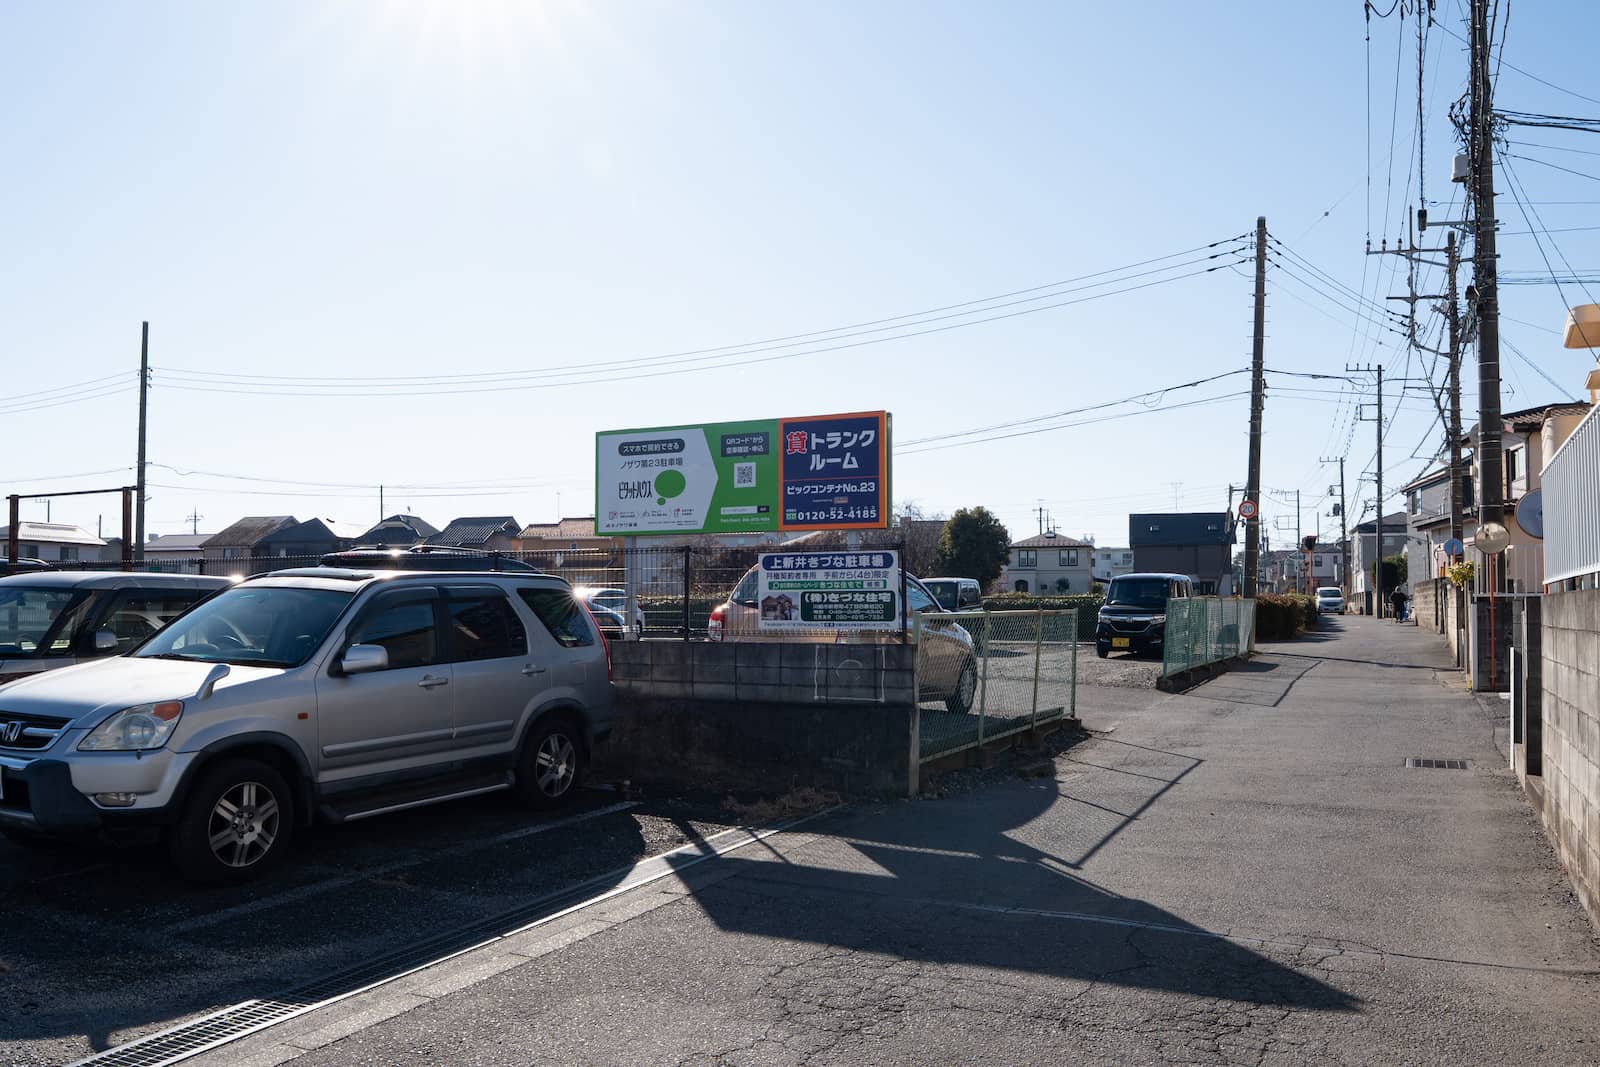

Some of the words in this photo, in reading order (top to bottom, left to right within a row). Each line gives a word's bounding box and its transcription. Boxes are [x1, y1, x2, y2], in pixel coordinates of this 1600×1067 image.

[809, 451, 859, 472] ルーム
[798, 509, 877, 521] 0120-52-4185
[1242, 504, 1253, 514] 20
[770, 554, 884, 569] 上新井きづな駐車場
